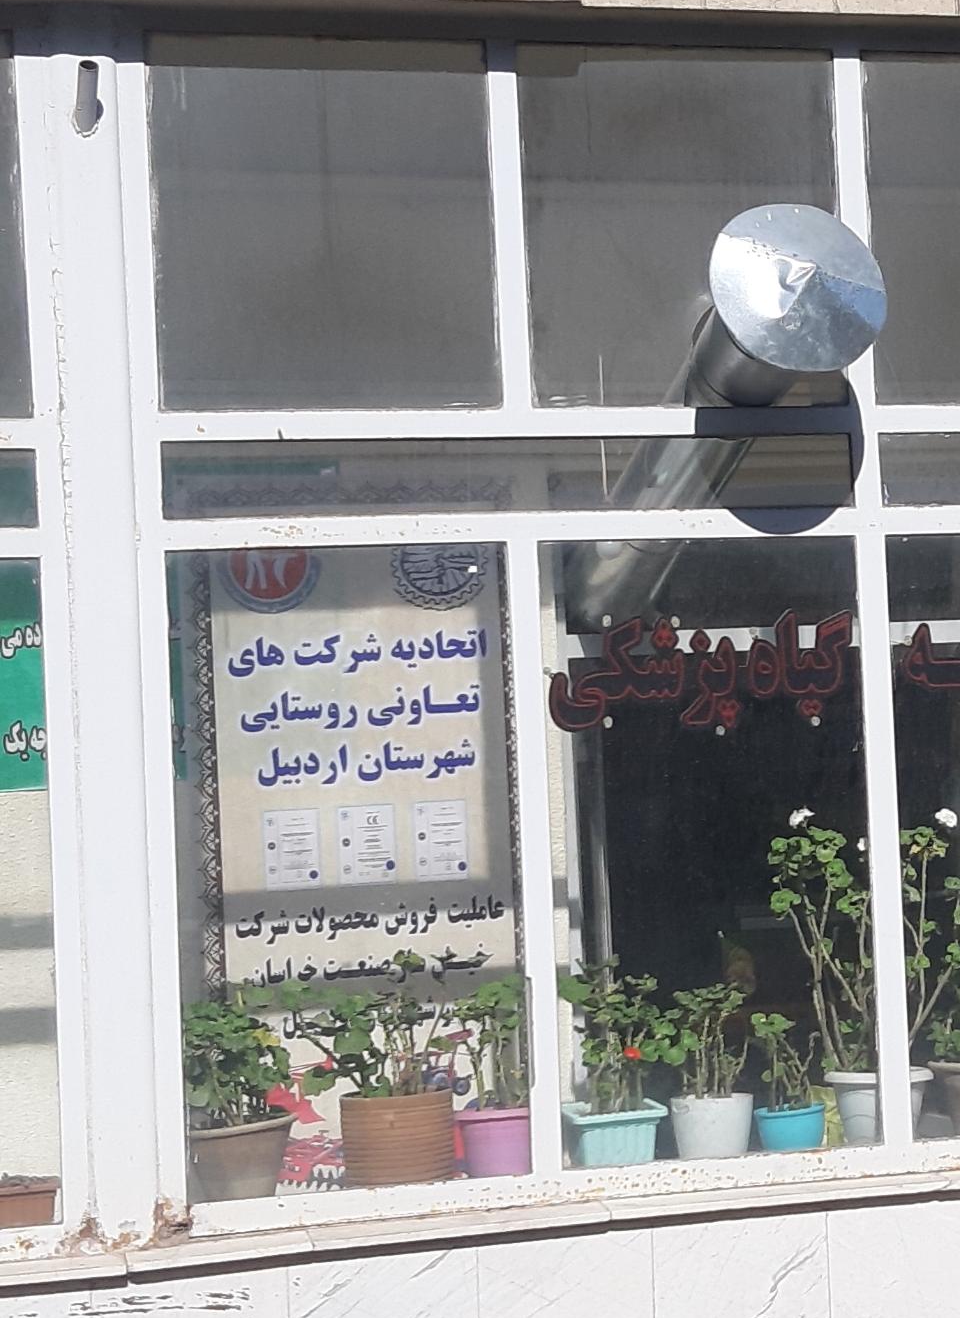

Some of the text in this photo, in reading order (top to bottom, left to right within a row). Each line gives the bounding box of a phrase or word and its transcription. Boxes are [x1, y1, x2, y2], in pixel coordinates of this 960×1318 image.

[227, 628, 488, 677] اتحادیه شرکت های
[550, 615, 743, 732] پزشکی
[748, 608, 853, 717] گیاه
[240, 683, 481, 733] تعاونی روستایی
[257, 738, 476, 786] شهرستان اردبیل
[235, 893, 505, 945] عاملیت فروش محصولات شرکت
